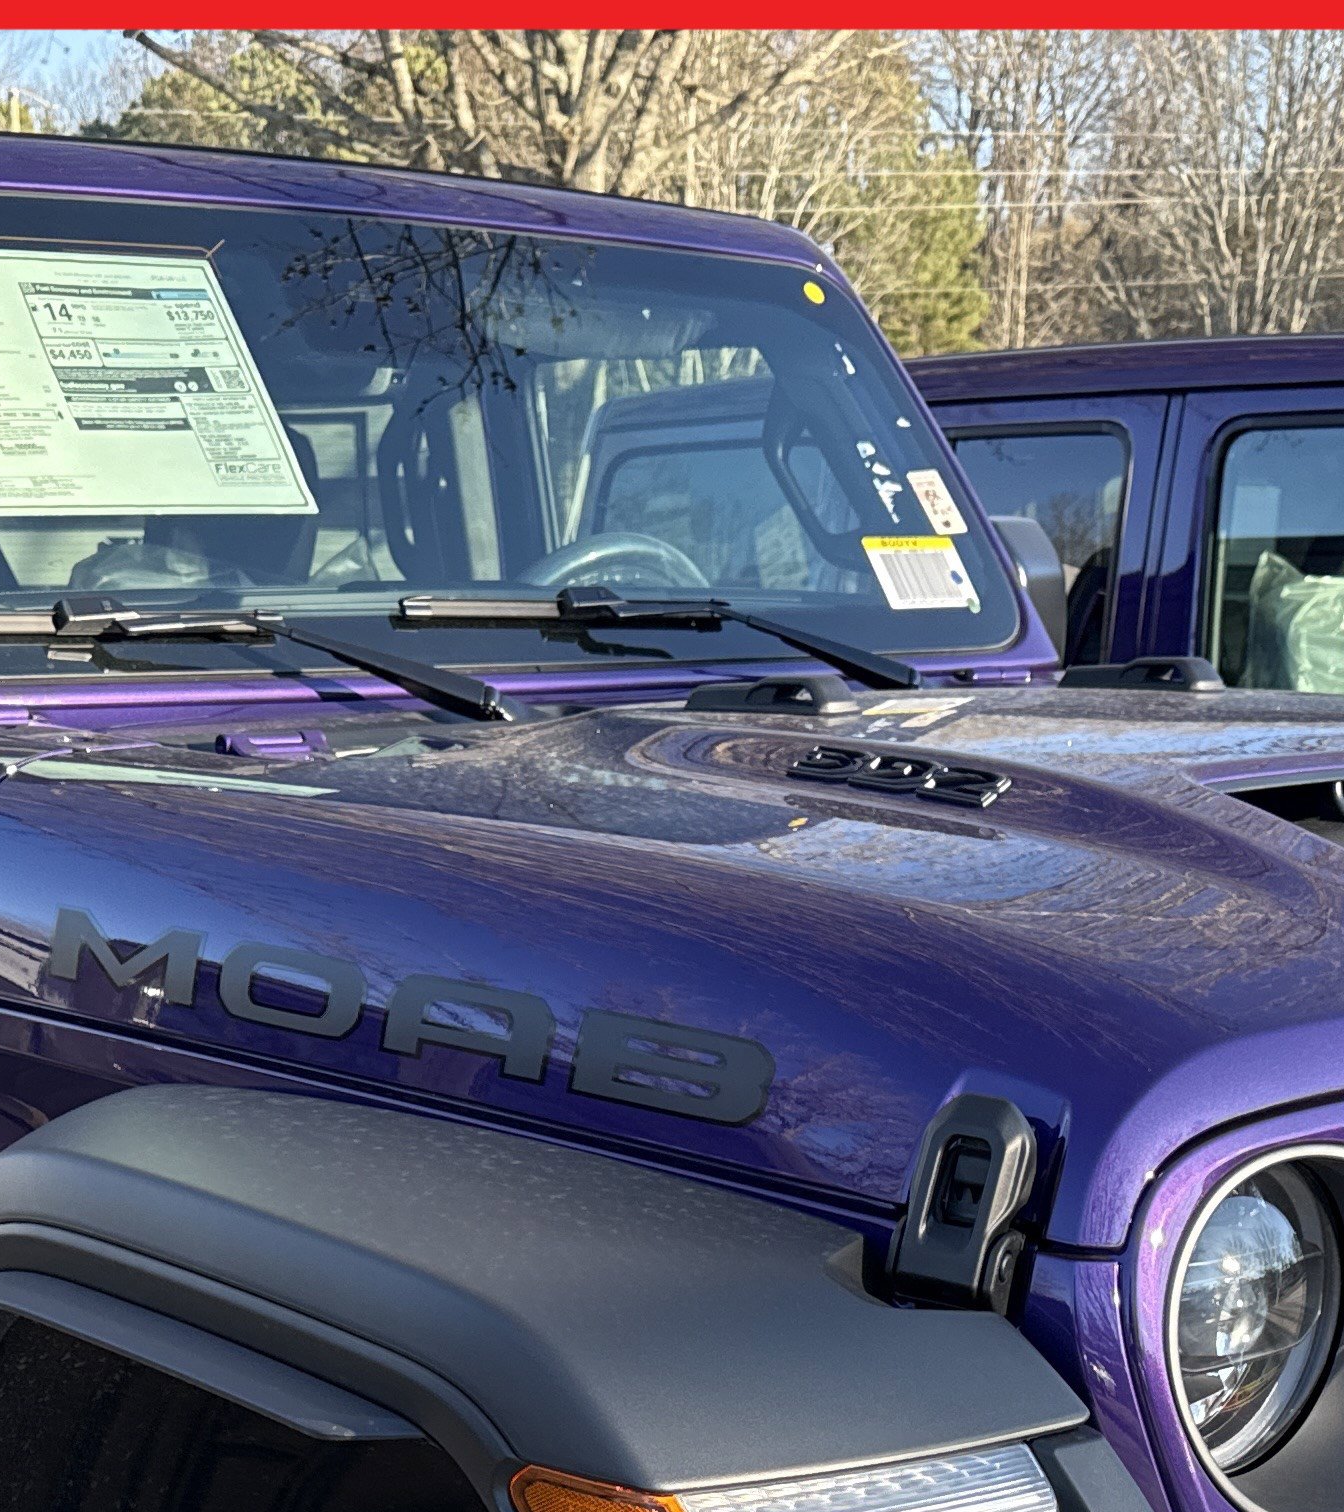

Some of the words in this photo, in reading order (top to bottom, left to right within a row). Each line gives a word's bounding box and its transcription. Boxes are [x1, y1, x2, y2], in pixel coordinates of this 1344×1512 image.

[50, 286, 80, 295] Economy
[92, 288, 133, 297] Environment
[43, 302, 73, 321] 14
[166, 310, 215, 322] $13,750
[49, 349, 93, 361] $4,450
[214, 462, 282, 474] FlexCare
[48, 906, 777, 1128] MOAB
